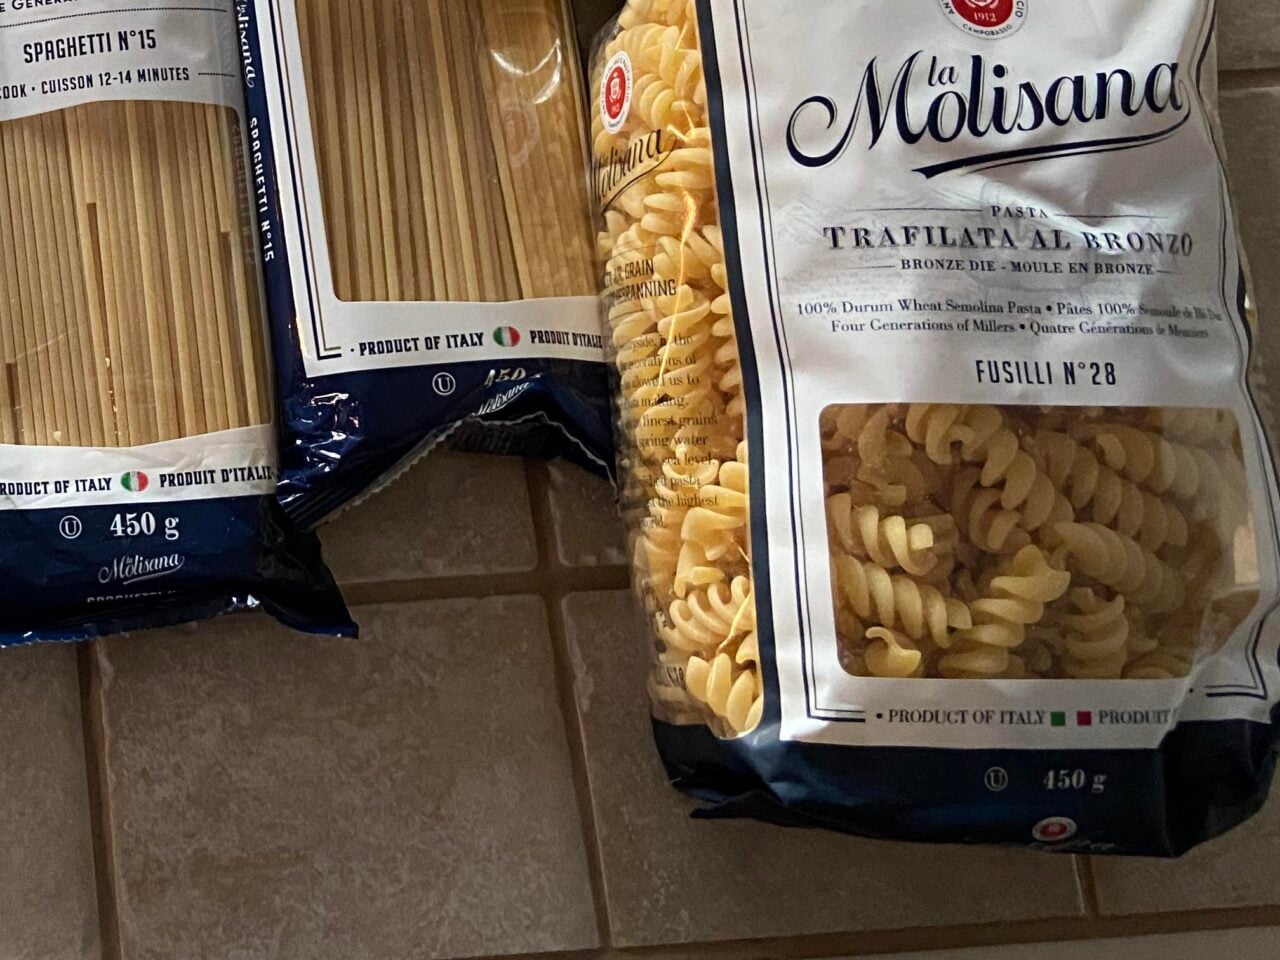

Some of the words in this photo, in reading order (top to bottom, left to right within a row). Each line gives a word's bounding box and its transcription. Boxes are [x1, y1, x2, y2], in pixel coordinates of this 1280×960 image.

[23, 32, 112, 64] SPAGHETTI
[41, 74, 94, 95] CUISSON
[99, 69, 132, 87] 12-14
[137, 67, 190, 83] MINUTES
[928, 55, 958, 87] la
[786, 50, 1191, 168] Molisana
[990, 206, 1049, 219] PASTA
[823, 226, 1017, 252] TRAFILATA
[1030, 229, 1071, 252] AL
[1081, 231, 1193, 257] BRONZO
[831, 319, 866, 333] Four
[870, 318, 954, 333] Generations
[957, 318, 972, 332] of
[972, 319, 1015, 333] Millers
[359, 336, 419, 356] PRODUCT
[425, 336, 440, 350] OF
[446, 332, 484, 349] ITALY
[976, 359, 1053, 385] FUSILLI
[54, 480, 70, 493] OF
[75, 477, 113, 492] ITALY
[159, 469, 216, 487] PRODUIT
[221, 465, 273, 483] D'ITALIE
[110, 511, 157, 537] 450
[164, 516, 180, 540] g
[888, 709, 969, 726] PRODUCT
[972, 710, 995, 725] OF
[999, 710, 1046, 726] ITALY
[1043, 769, 1086, 790] 450
[1092, 773, 1107, 794] g
